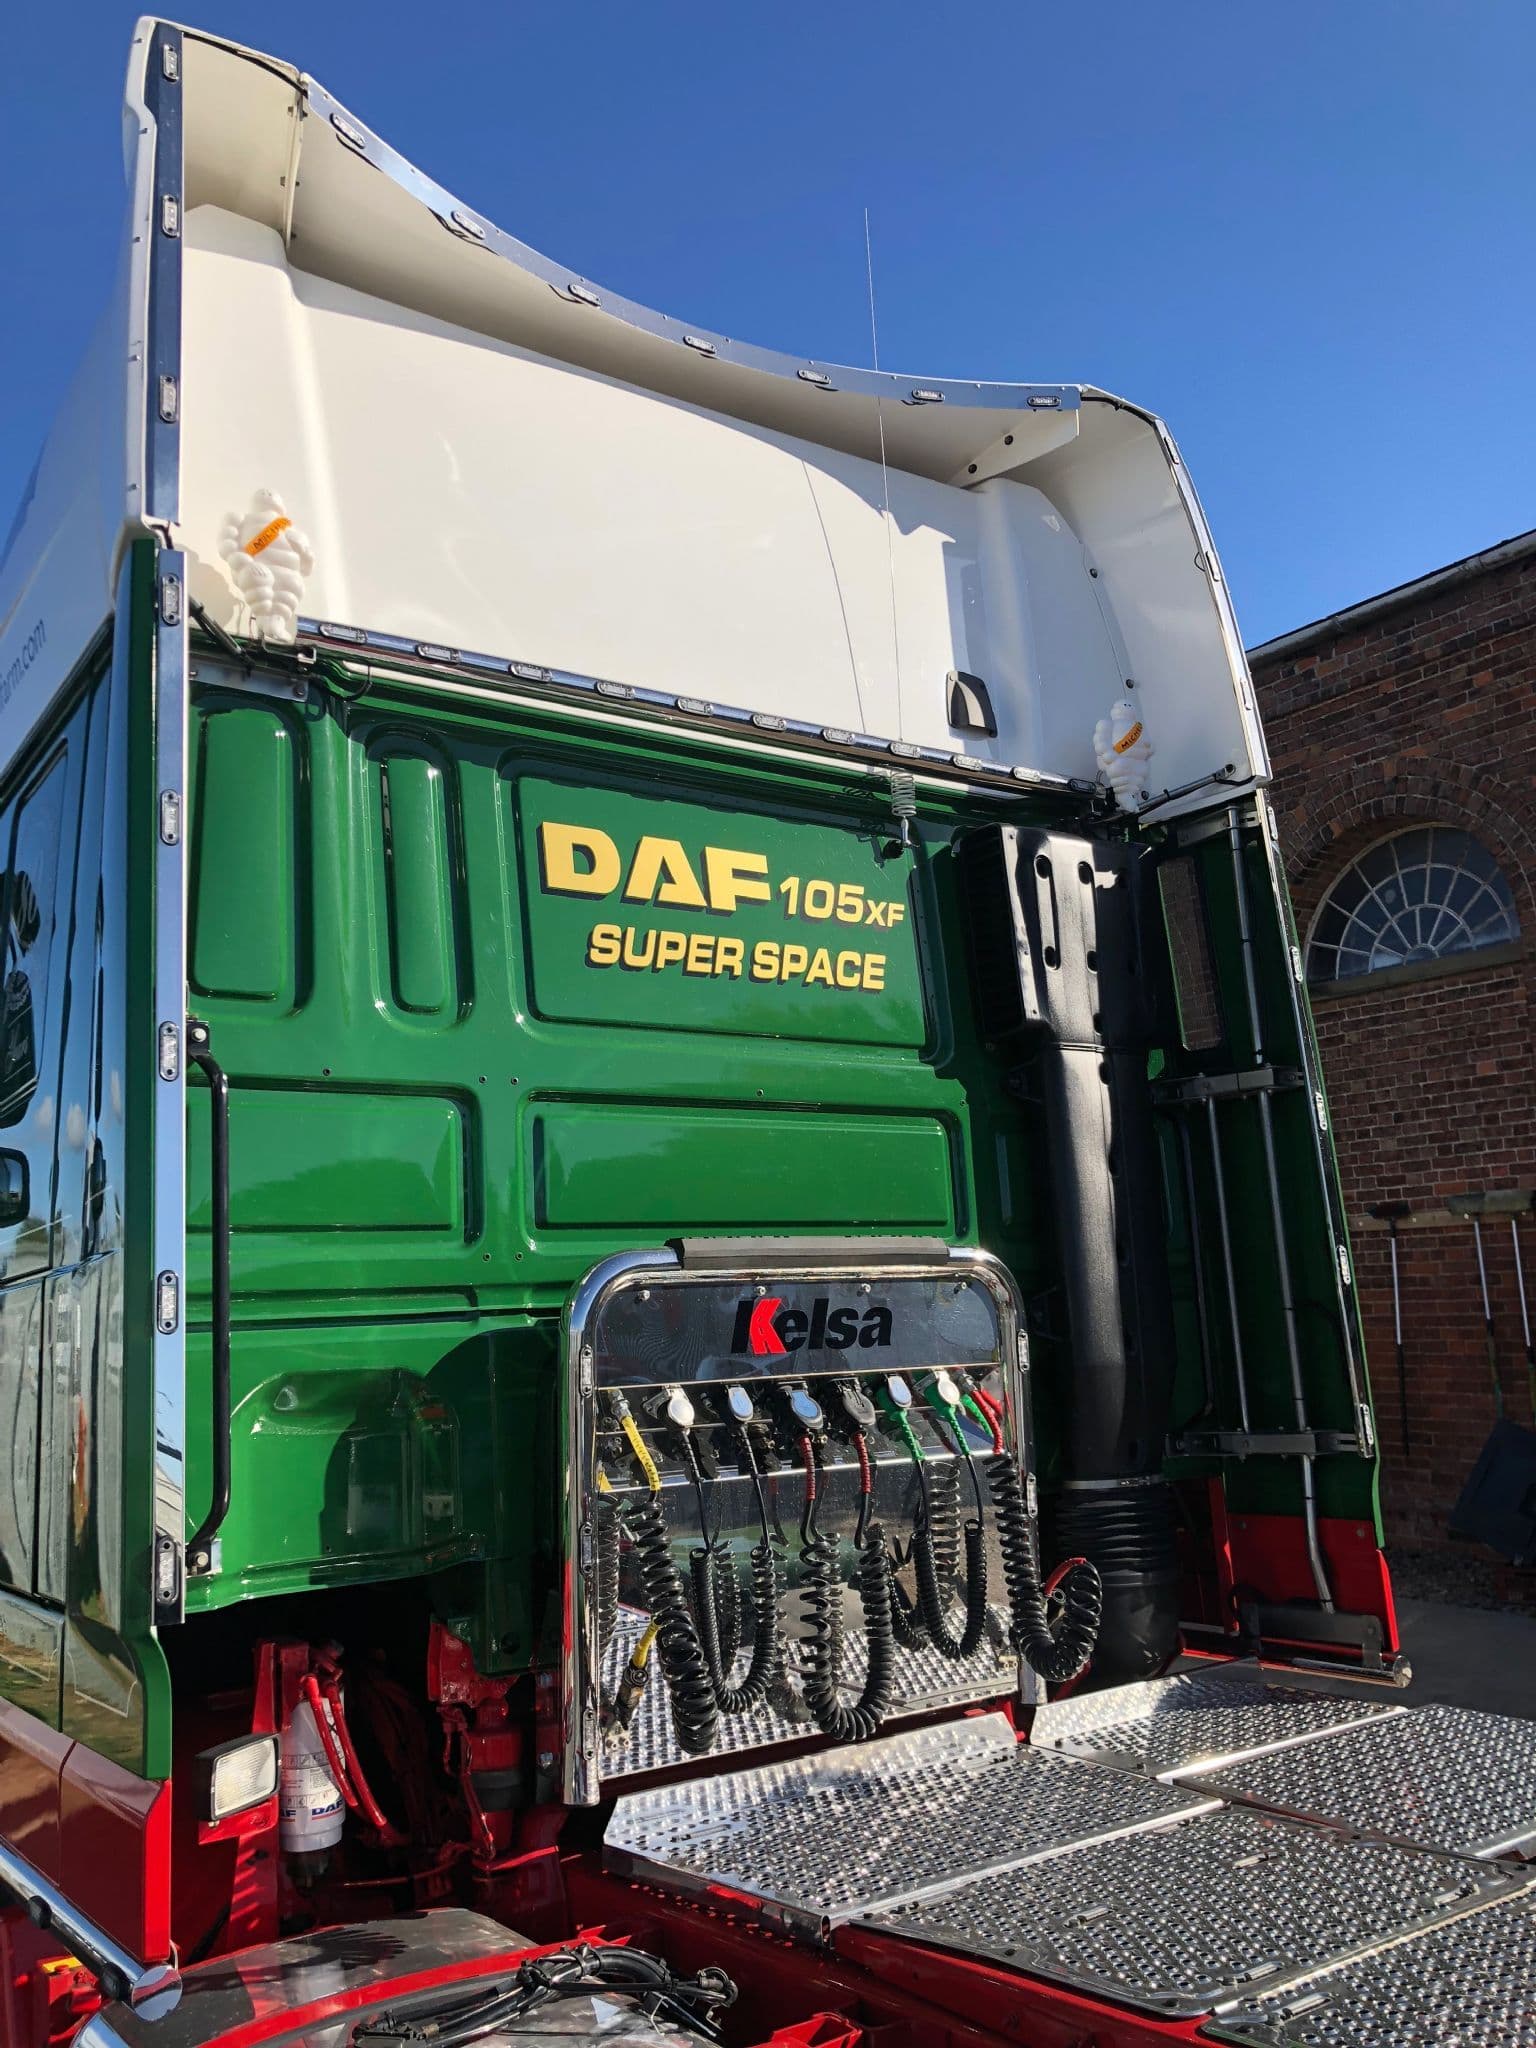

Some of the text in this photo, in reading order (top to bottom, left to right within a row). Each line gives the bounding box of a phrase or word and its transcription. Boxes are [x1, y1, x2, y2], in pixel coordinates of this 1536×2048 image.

[540, 822, 905, 928] DAF 105XF
[588, 924, 886, 991] SUPER SPACE
[731, 1298, 893, 1355] Kelsa
[312, 1800, 344, 1817] DAF
